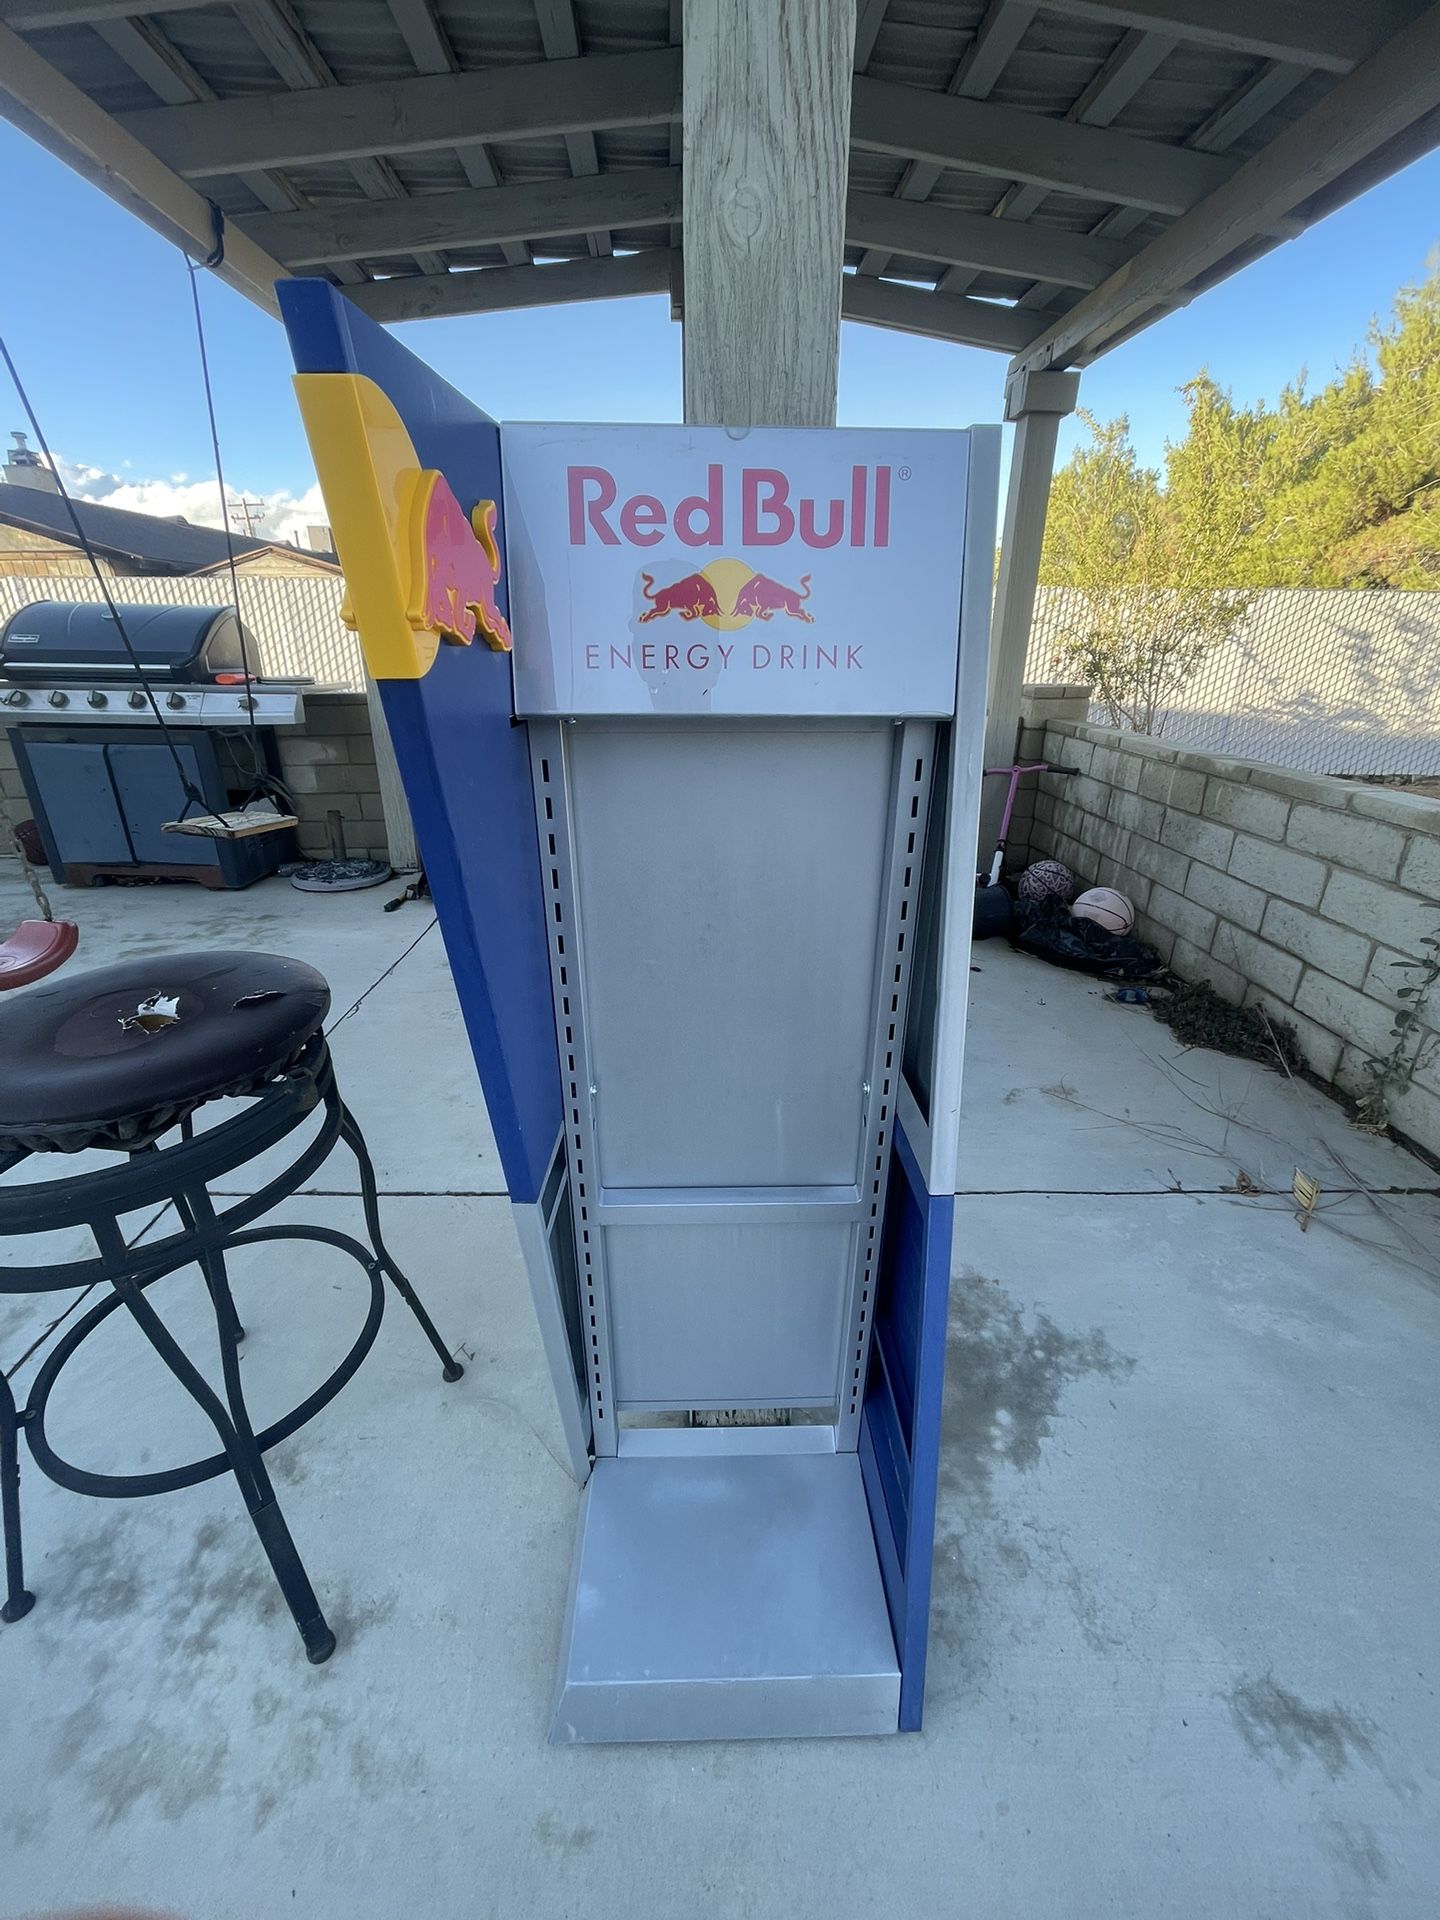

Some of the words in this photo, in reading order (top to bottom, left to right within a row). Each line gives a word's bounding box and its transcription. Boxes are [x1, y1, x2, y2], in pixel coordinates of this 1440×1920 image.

[567, 464, 723, 547] Red
[742, 465, 891, 549] Bull
[586, 644, 735, 670] ENERGY
[752, 644, 865, 670] DRINK
